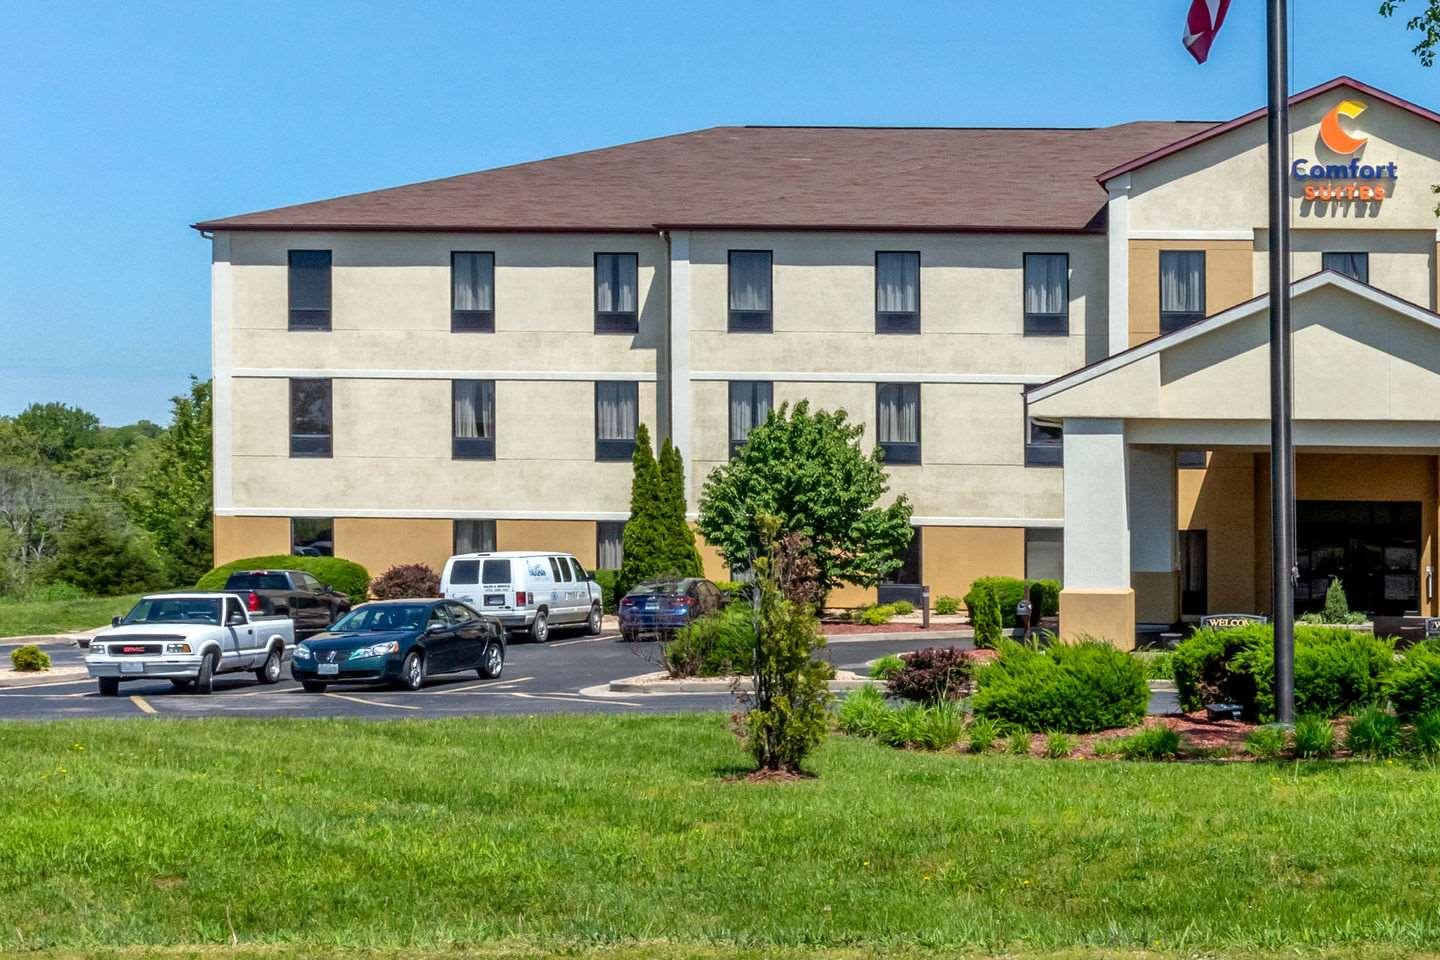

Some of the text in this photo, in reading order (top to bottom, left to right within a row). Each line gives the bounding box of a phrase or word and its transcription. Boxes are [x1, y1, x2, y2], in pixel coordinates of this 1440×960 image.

[1291, 158, 1398, 180] Comfort
[1304, 184, 1386, 201] SUITES
[1209, 618, 1250, 627] WELCO
